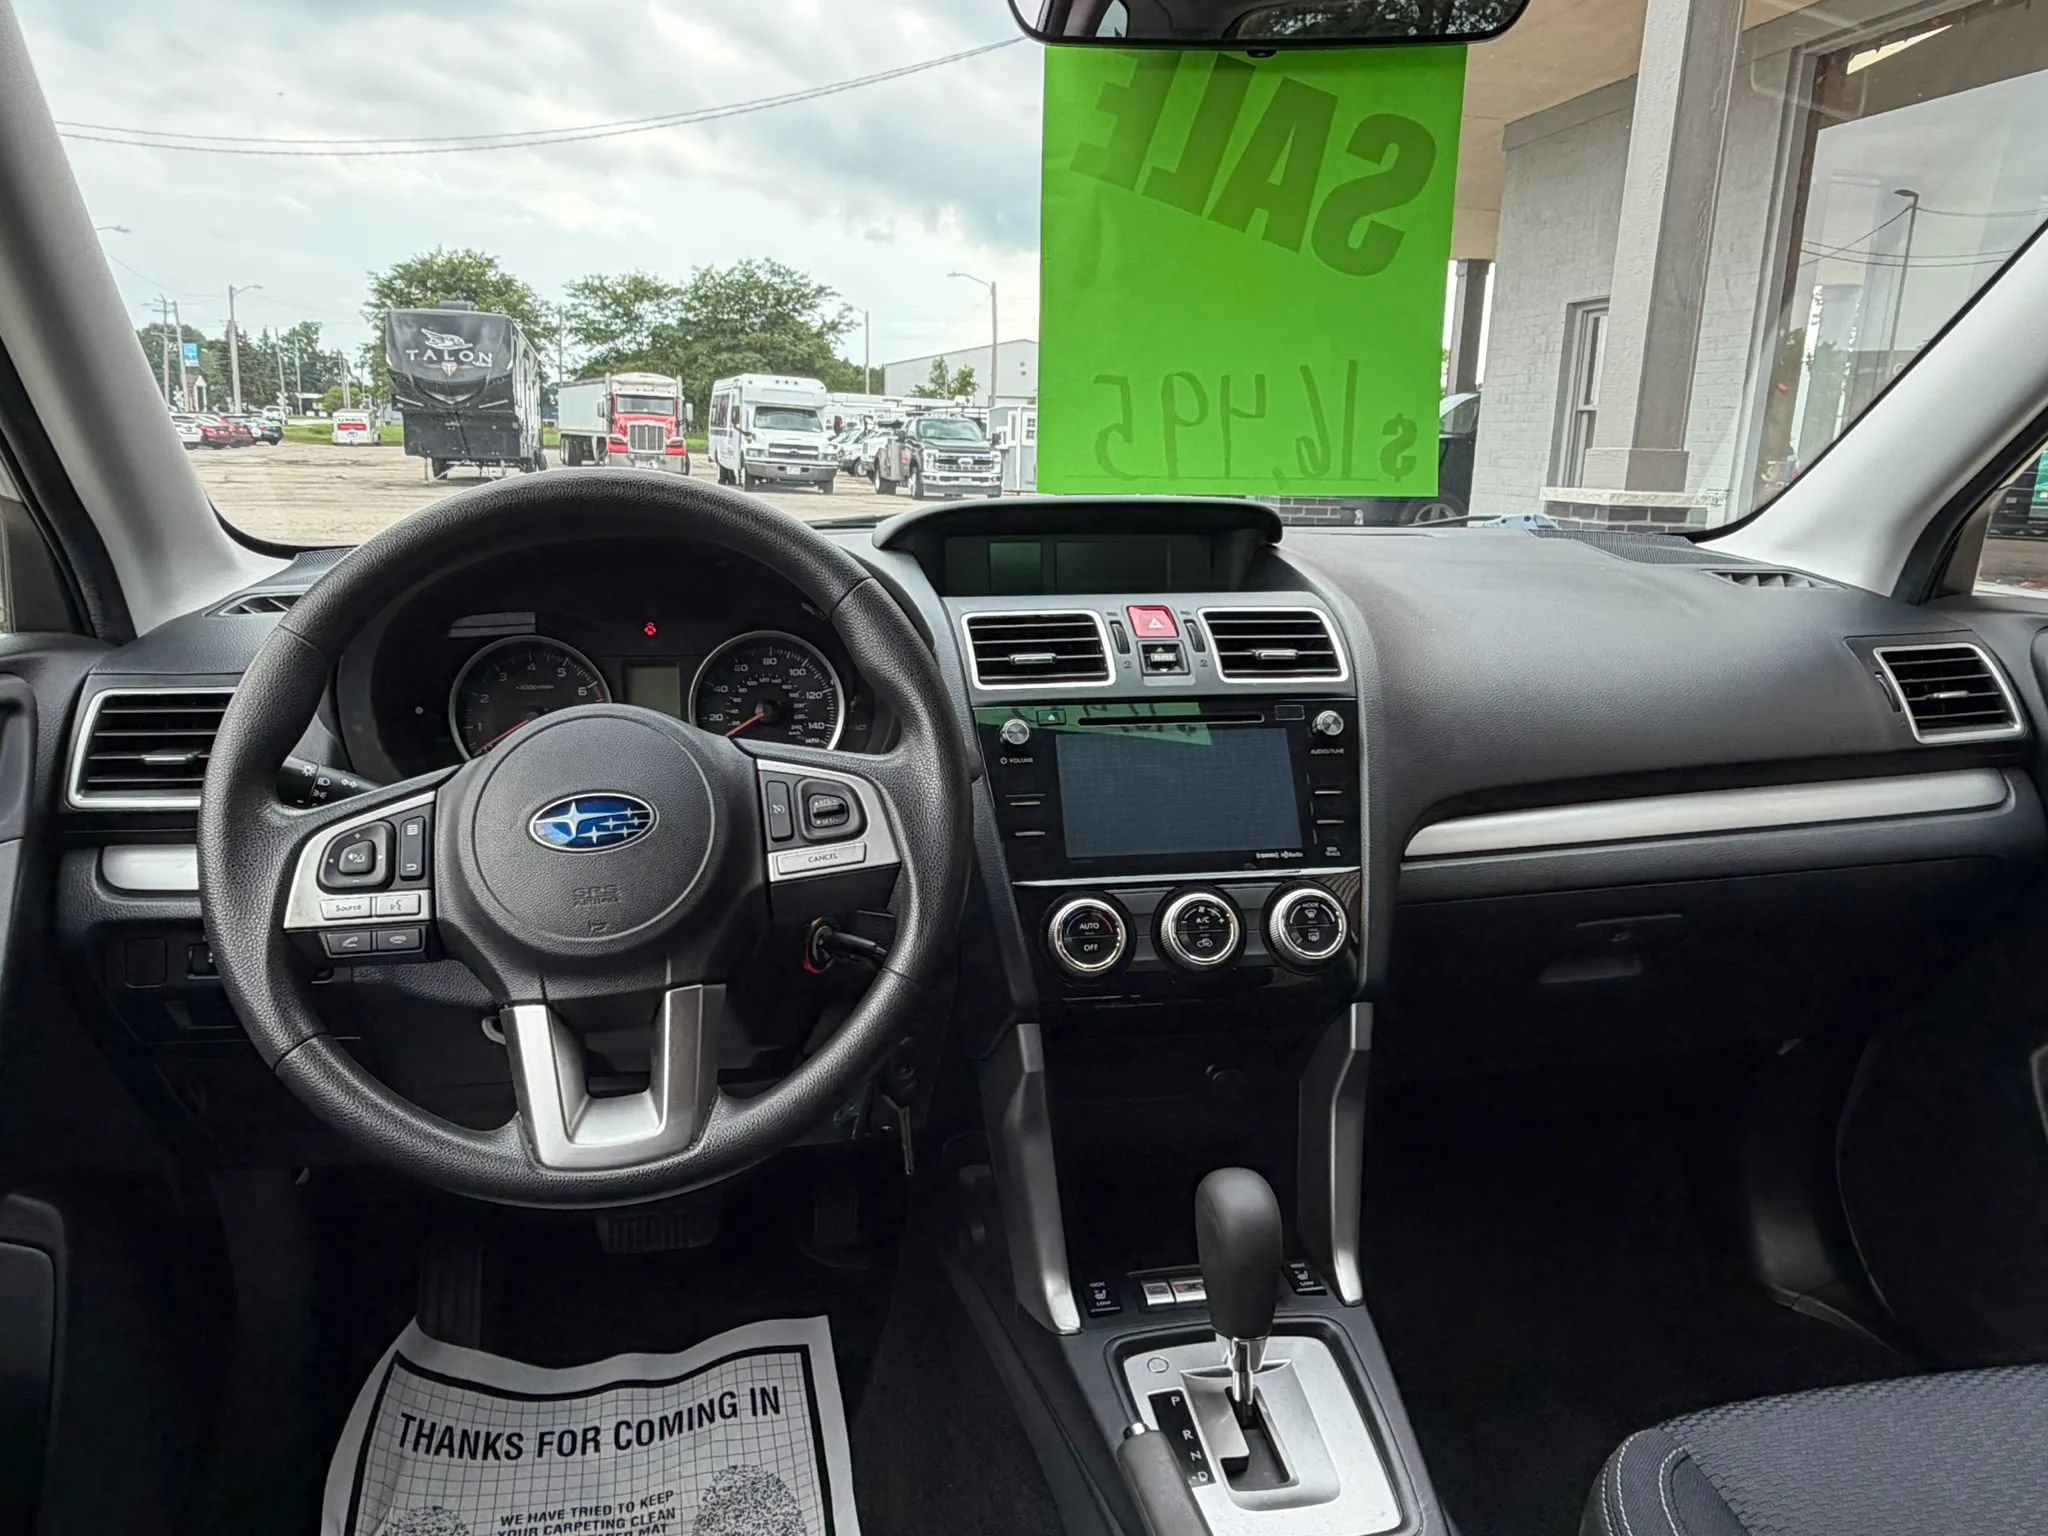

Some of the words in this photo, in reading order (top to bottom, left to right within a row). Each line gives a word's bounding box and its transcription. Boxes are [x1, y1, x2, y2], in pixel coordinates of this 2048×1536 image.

[405, 349, 493, 365] TALON
[763, 657, 777, 665] 80
[527, 663, 536, 671] 4
[734, 664, 748, 672] 60
[557, 668, 566, 677] 5
[789, 668, 806, 676] 100
[499, 673, 508, 682] 3
[577, 688, 587, 696] 6
[806, 691, 823, 699] 120
[480, 694, 489, 703] 2
[709, 713, 724, 721] 20
[807, 853, 839, 864] CANCEL
[335, 904, 362, 912] Source
[1195, 916, 1210, 924] A/C
[1079, 922, 1100, 931] AUTO
[1083, 943, 1099, 952] OFF
[1170, 1395, 1181, 1407] P
[399, 1411, 525, 1461] THANKS
[537, 1425, 602, 1459] FOR
[613, 1390, 738, 1451] COMING
[749, 1385, 781, 1418] IN
[1182, 1429, 1194, 1440] R
[1189, 1449, 1202, 1461] N
[1197, 1470, 1209, 1482] D
[500, 1514, 524, 1527] WE
[527, 1510, 565, 1523] HAVE
[570, 1504, 613, 1518] TRIED
[617, 1501, 635, 1514] TO
[640, 1490, 675, 1509] KEEP
[543, 1518, 627, 1536] CARPETING
[630, 1507, 676, 1527] CLEAN
[639, 1524, 669, 1536] MAT
